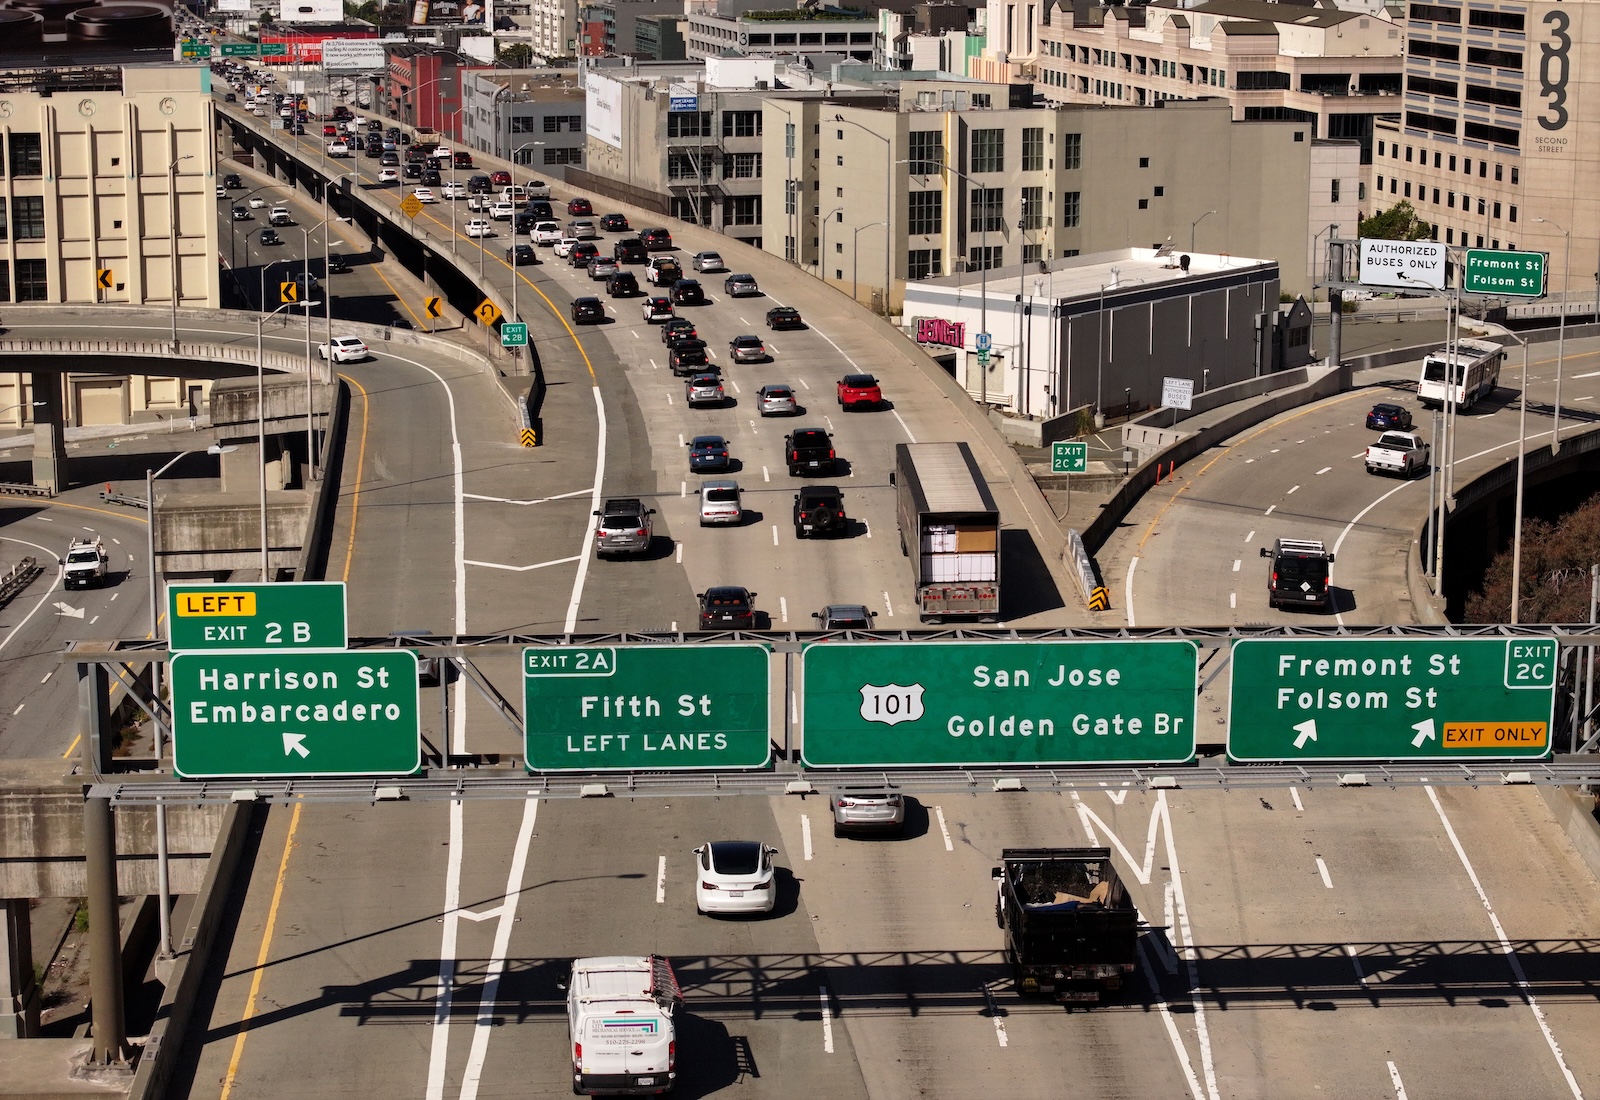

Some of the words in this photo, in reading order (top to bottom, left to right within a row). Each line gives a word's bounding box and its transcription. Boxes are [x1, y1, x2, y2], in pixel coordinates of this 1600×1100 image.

[740, 32, 748, 46] 3
[1538, 10, 1571, 130] 303
[1538, 145, 1564, 154] STREET
[1370, 245, 1436, 255] AUTHORIZED
[1368, 257, 1402, 266] BUSES
[1410, 260, 1437, 268] ONLY
[1471, 258, 1519, 269] Fremont
[1526, 261, 1539, 270] St
[1474, 275, 1514, 286] Folsom
[1521, 278, 1534, 287] St
[512, 334, 523, 342] 2B
[1164, 387, 1192, 395] AUTHORIZED
[1167, 393, 1187, 401] BUSES
[1056, 446, 1082, 456] EXIT
[1054, 458, 1070, 469] 2C
[188, 597, 244, 612] LEFT
[205, 626, 247, 640] EXIT
[1514, 646, 1551, 657] EXIT
[529, 656, 567, 667] EXIT
[576, 653, 608, 669] 2A
[1279, 655, 1411, 676] Fremont
[1429, 654, 1460, 675] St
[973, 666, 1029, 687] San
[1048, 665, 1120, 686] Jose
[1516, 663, 1545, 679] 2C
[200, 668, 337, 690] Harrison
[357, 667, 388, 688] St
[875, 695, 910, 714] 101
[1278, 688, 1387, 709] Folsom
[1406, 687, 1437, 708] St
[191, 700, 400, 723] Embarcadero
[582, 696, 660, 717] Fifth
[678, 695, 711, 716] St
[948, 716, 1053, 737] Golden
[1072, 714, 1142, 735] Gate
[1155, 713, 1183, 734] Br
[1447, 729, 1484, 741] EXIT
[1495, 728, 1541, 740] ONLY
[568, 735, 629, 752] LEFT
[644, 733, 727, 750] LANES
